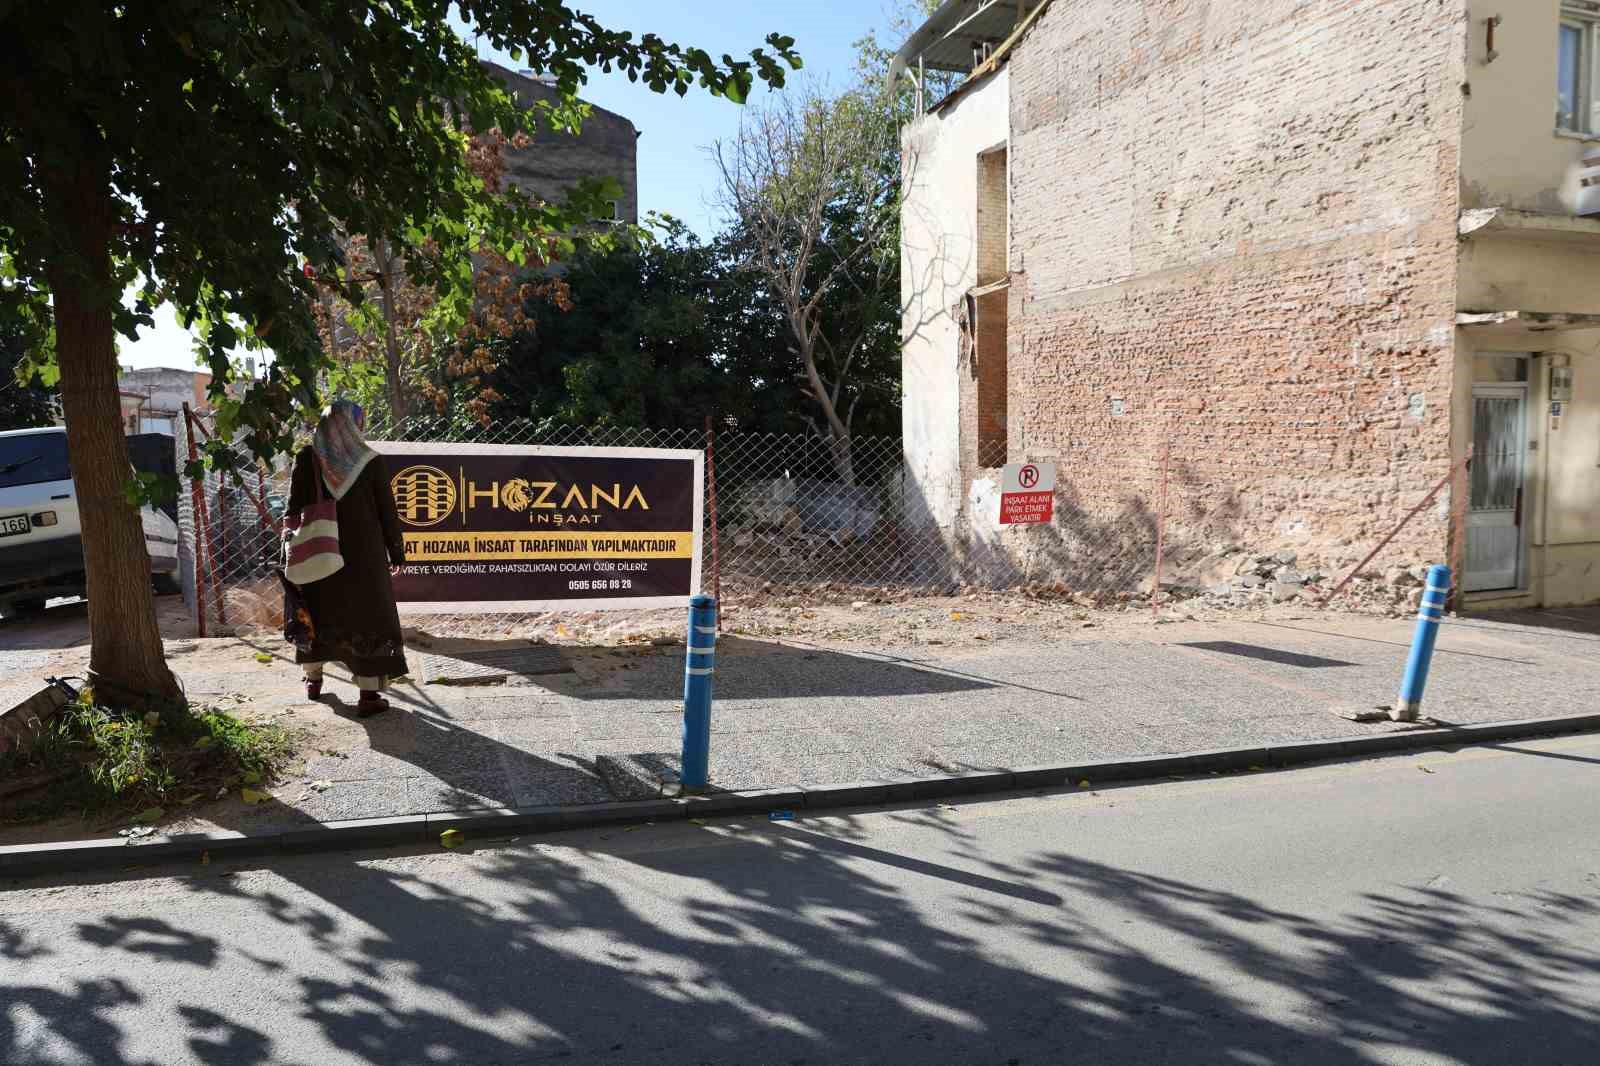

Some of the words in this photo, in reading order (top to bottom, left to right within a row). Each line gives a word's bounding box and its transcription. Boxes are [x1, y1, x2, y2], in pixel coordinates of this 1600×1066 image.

[1029, 495, 1050, 503] ALANI
[1005, 505, 1024, 513] PARK
[1025, 504, 1047, 512] ETMEK
[529, 511, 602, 526] İNŞAAT
[1010, 513, 1041, 522] YASAKTIR
[404, 541, 419, 554] AT
[423, 540, 470, 553] HOZANA
[520, 539, 588, 553] TARAFINDAN
[591, 539, 677, 552] YAPILMAKTADIR
[402, 565, 430, 575] VREYE
[489, 563, 558, 574] RAHATSIZLIKTAN
[559, 563, 591, 572] DOLAYI
[593, 561, 615, 571] ÖZÜR
[617, 561, 648, 571] DİLERİZ
[568, 580, 590, 590] 0505
